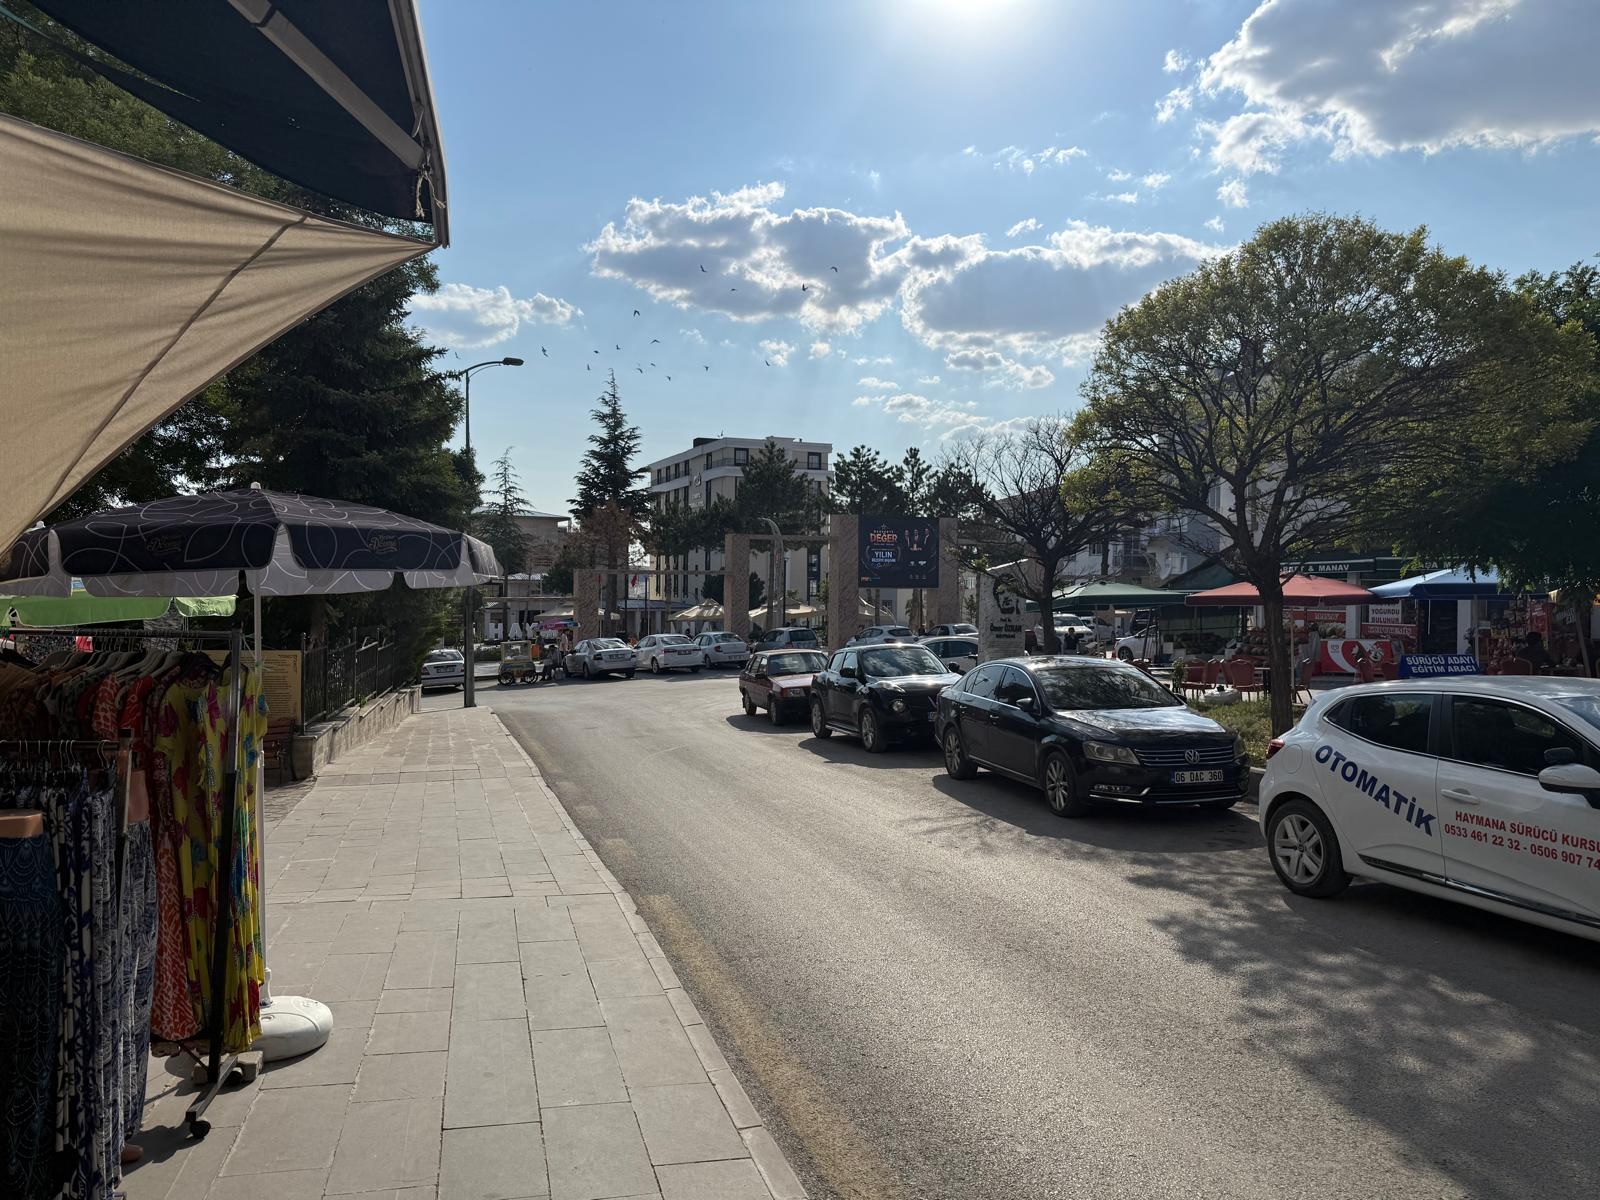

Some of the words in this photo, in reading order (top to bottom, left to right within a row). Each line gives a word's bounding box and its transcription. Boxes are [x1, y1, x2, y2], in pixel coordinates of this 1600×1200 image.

[1318, 563, 1350, 572] MANAV
[1406, 655, 1446, 665] SÜRÜCÜ
[1447, 655, 1476, 665] ADAYI
[1411, 665, 1446, 673] EĞİTİM
[1447, 665, 1477, 673] ARACI
[1175, 772, 1186, 783] 06
[1315, 745, 1436, 837] OTOMATİK
[1455, 810, 1507, 832] HAYMANA
[1509, 822, 1558, 843] SÜRÜCÜ
[1444, 823, 1468, 838] 0533
[1470, 830, 1489, 843] 461
[1491, 834, 1505, 847] 22
[1507, 838, 1521, 851] 32
[1530, 843, 1558, 860] 0506
[1561, 850, 1583, 866] 907
